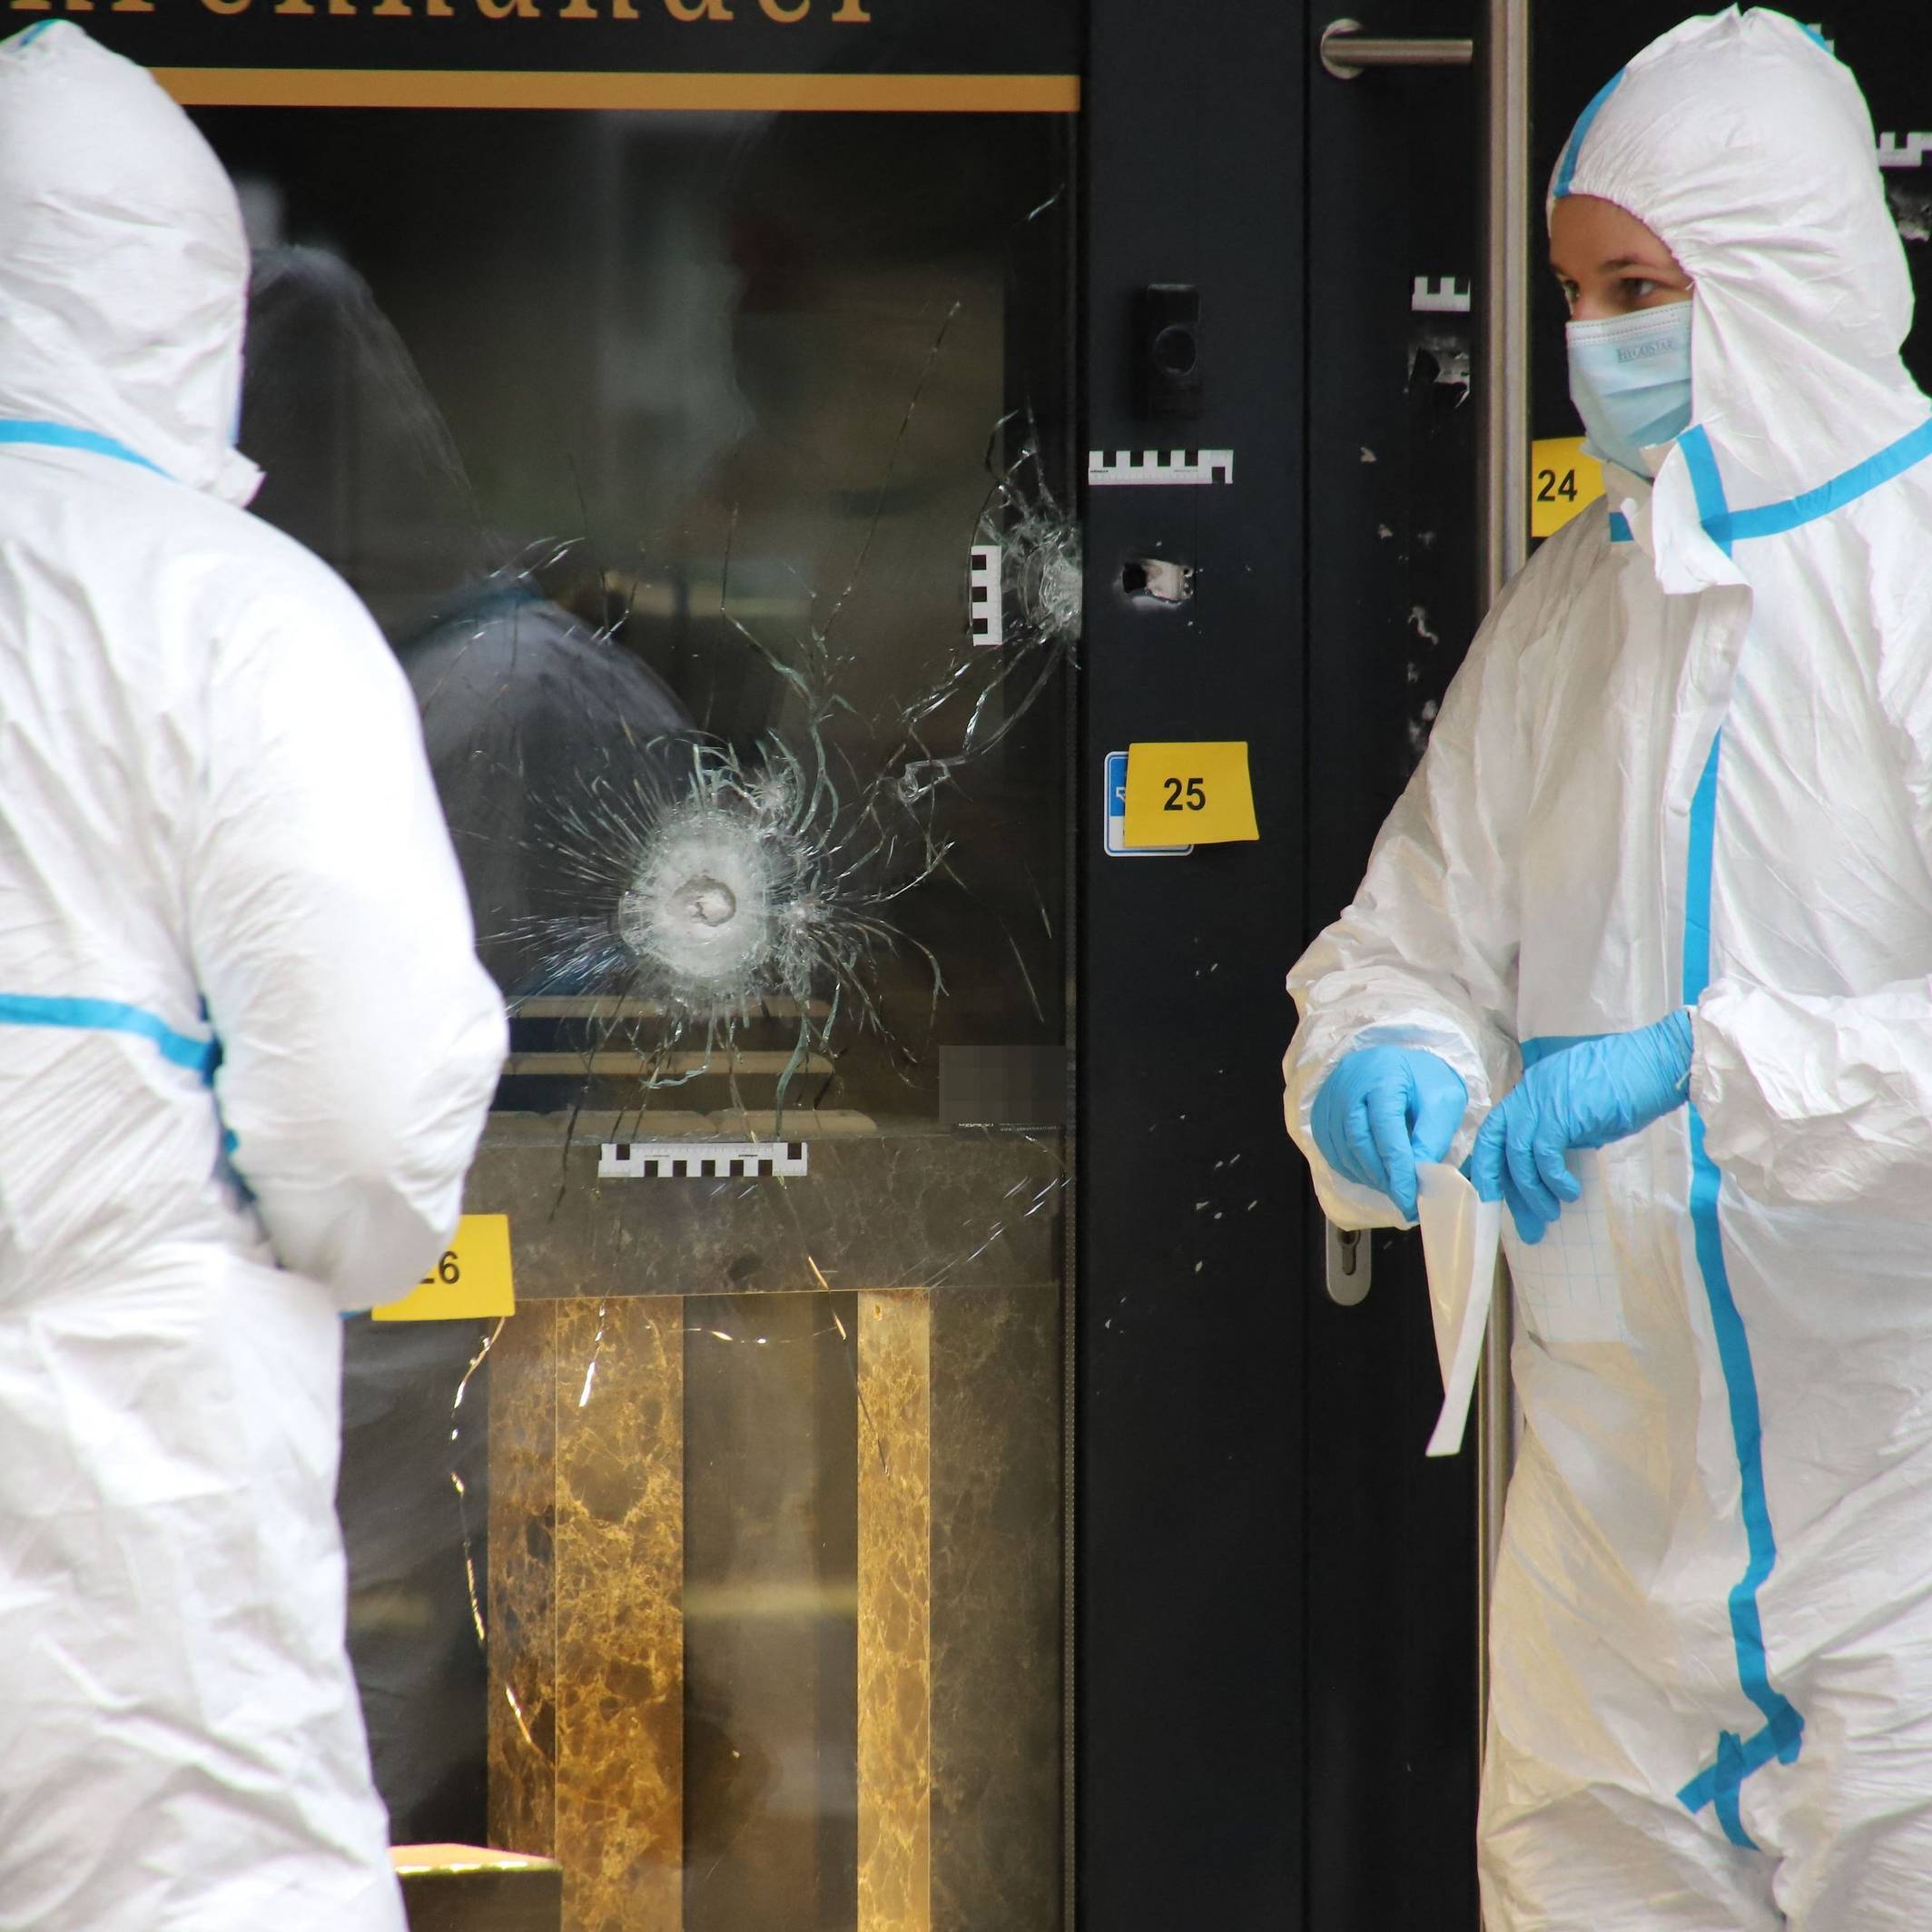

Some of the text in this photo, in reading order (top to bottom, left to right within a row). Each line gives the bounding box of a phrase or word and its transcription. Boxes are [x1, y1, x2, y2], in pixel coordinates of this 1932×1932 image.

[1537, 469, 1578, 501] 24
[1163, 778, 1206, 811] 25
[420, 1251, 460, 1284] 6
